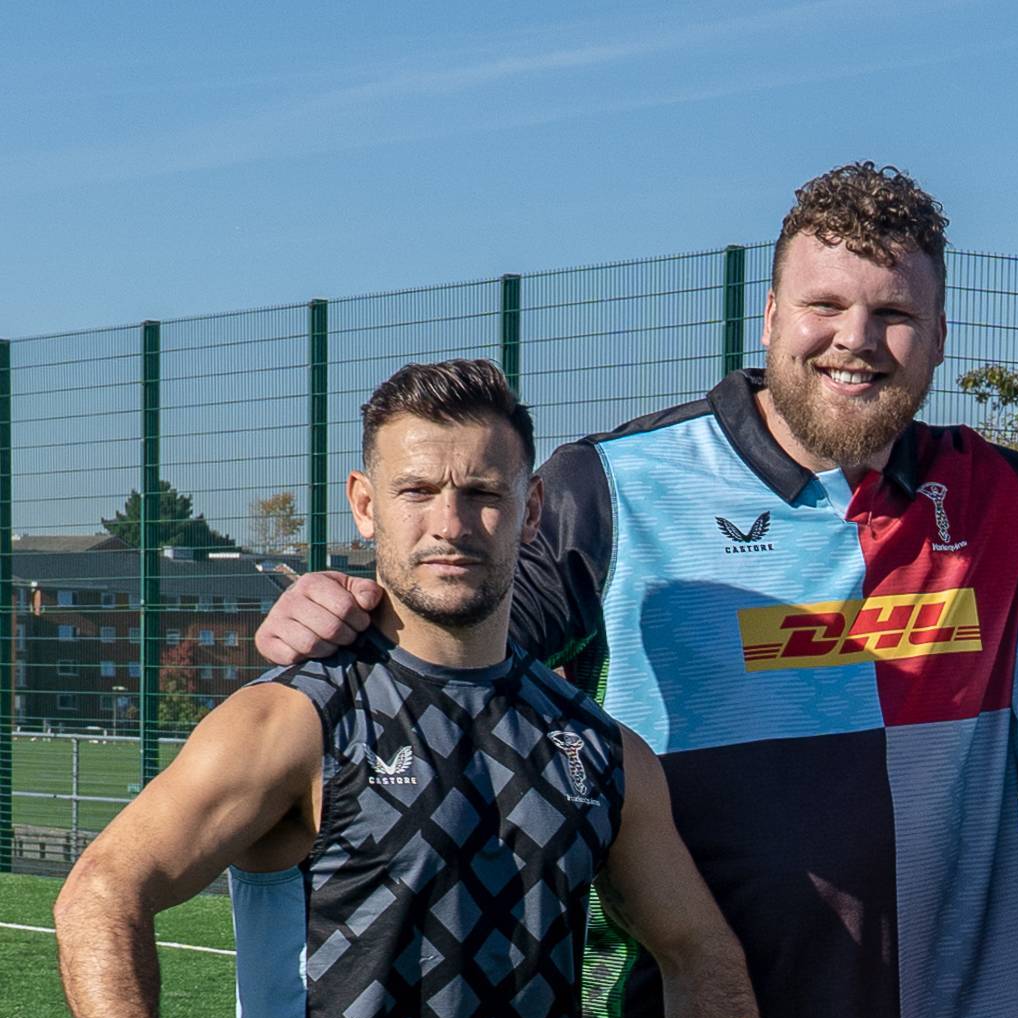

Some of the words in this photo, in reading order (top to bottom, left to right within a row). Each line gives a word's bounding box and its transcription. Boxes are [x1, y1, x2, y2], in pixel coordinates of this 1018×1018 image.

[725, 544, 775, 554] CASTORE
[779, 601, 955, 658] DHL
[368, 776, 417, 785] CASTORE
